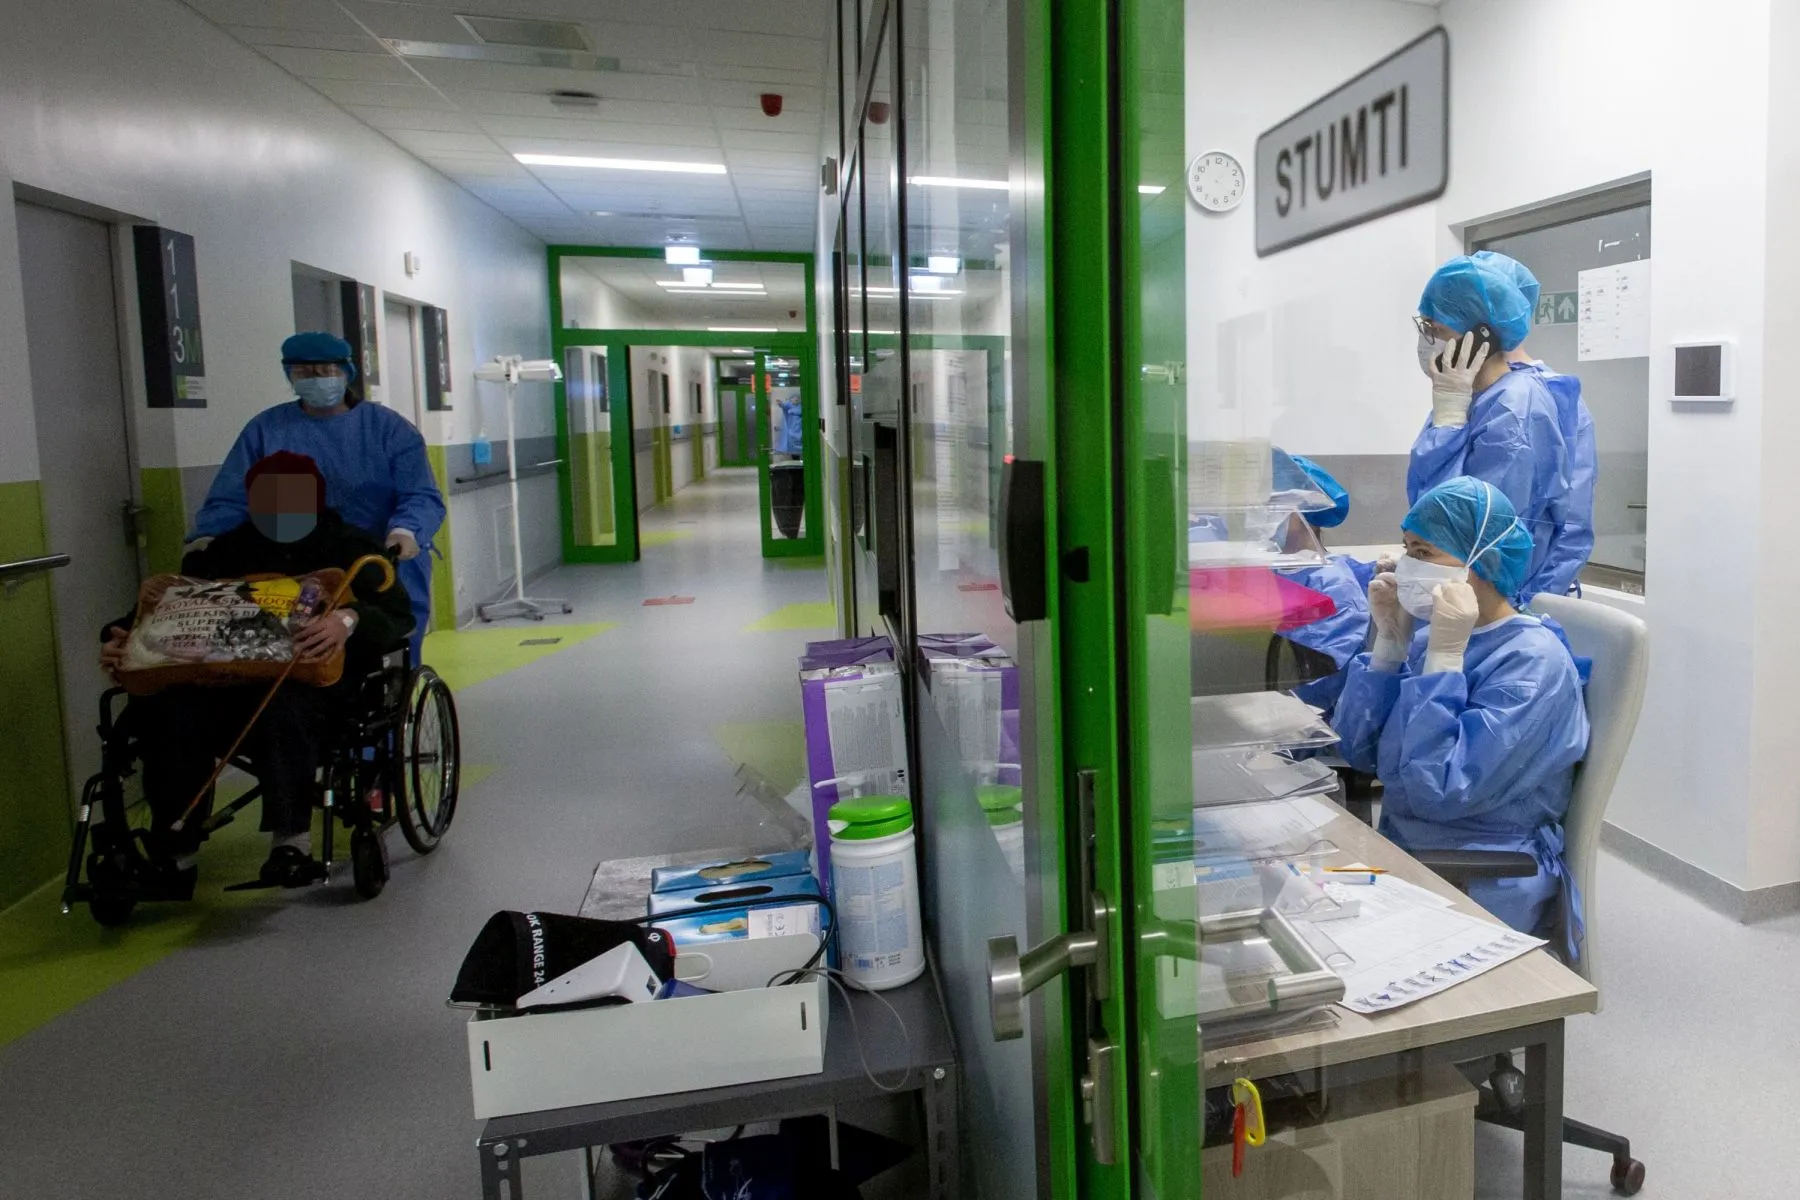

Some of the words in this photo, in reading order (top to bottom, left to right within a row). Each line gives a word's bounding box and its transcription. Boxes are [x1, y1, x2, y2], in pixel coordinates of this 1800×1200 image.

[1275, 85, 1410, 218] STUMTI
[1215, 156, 1223, 165] 12
[1234, 179, 1240, 187] 3
[1223, 195, 1229, 203] 5
[532, 929, 546, 969] RANGE
